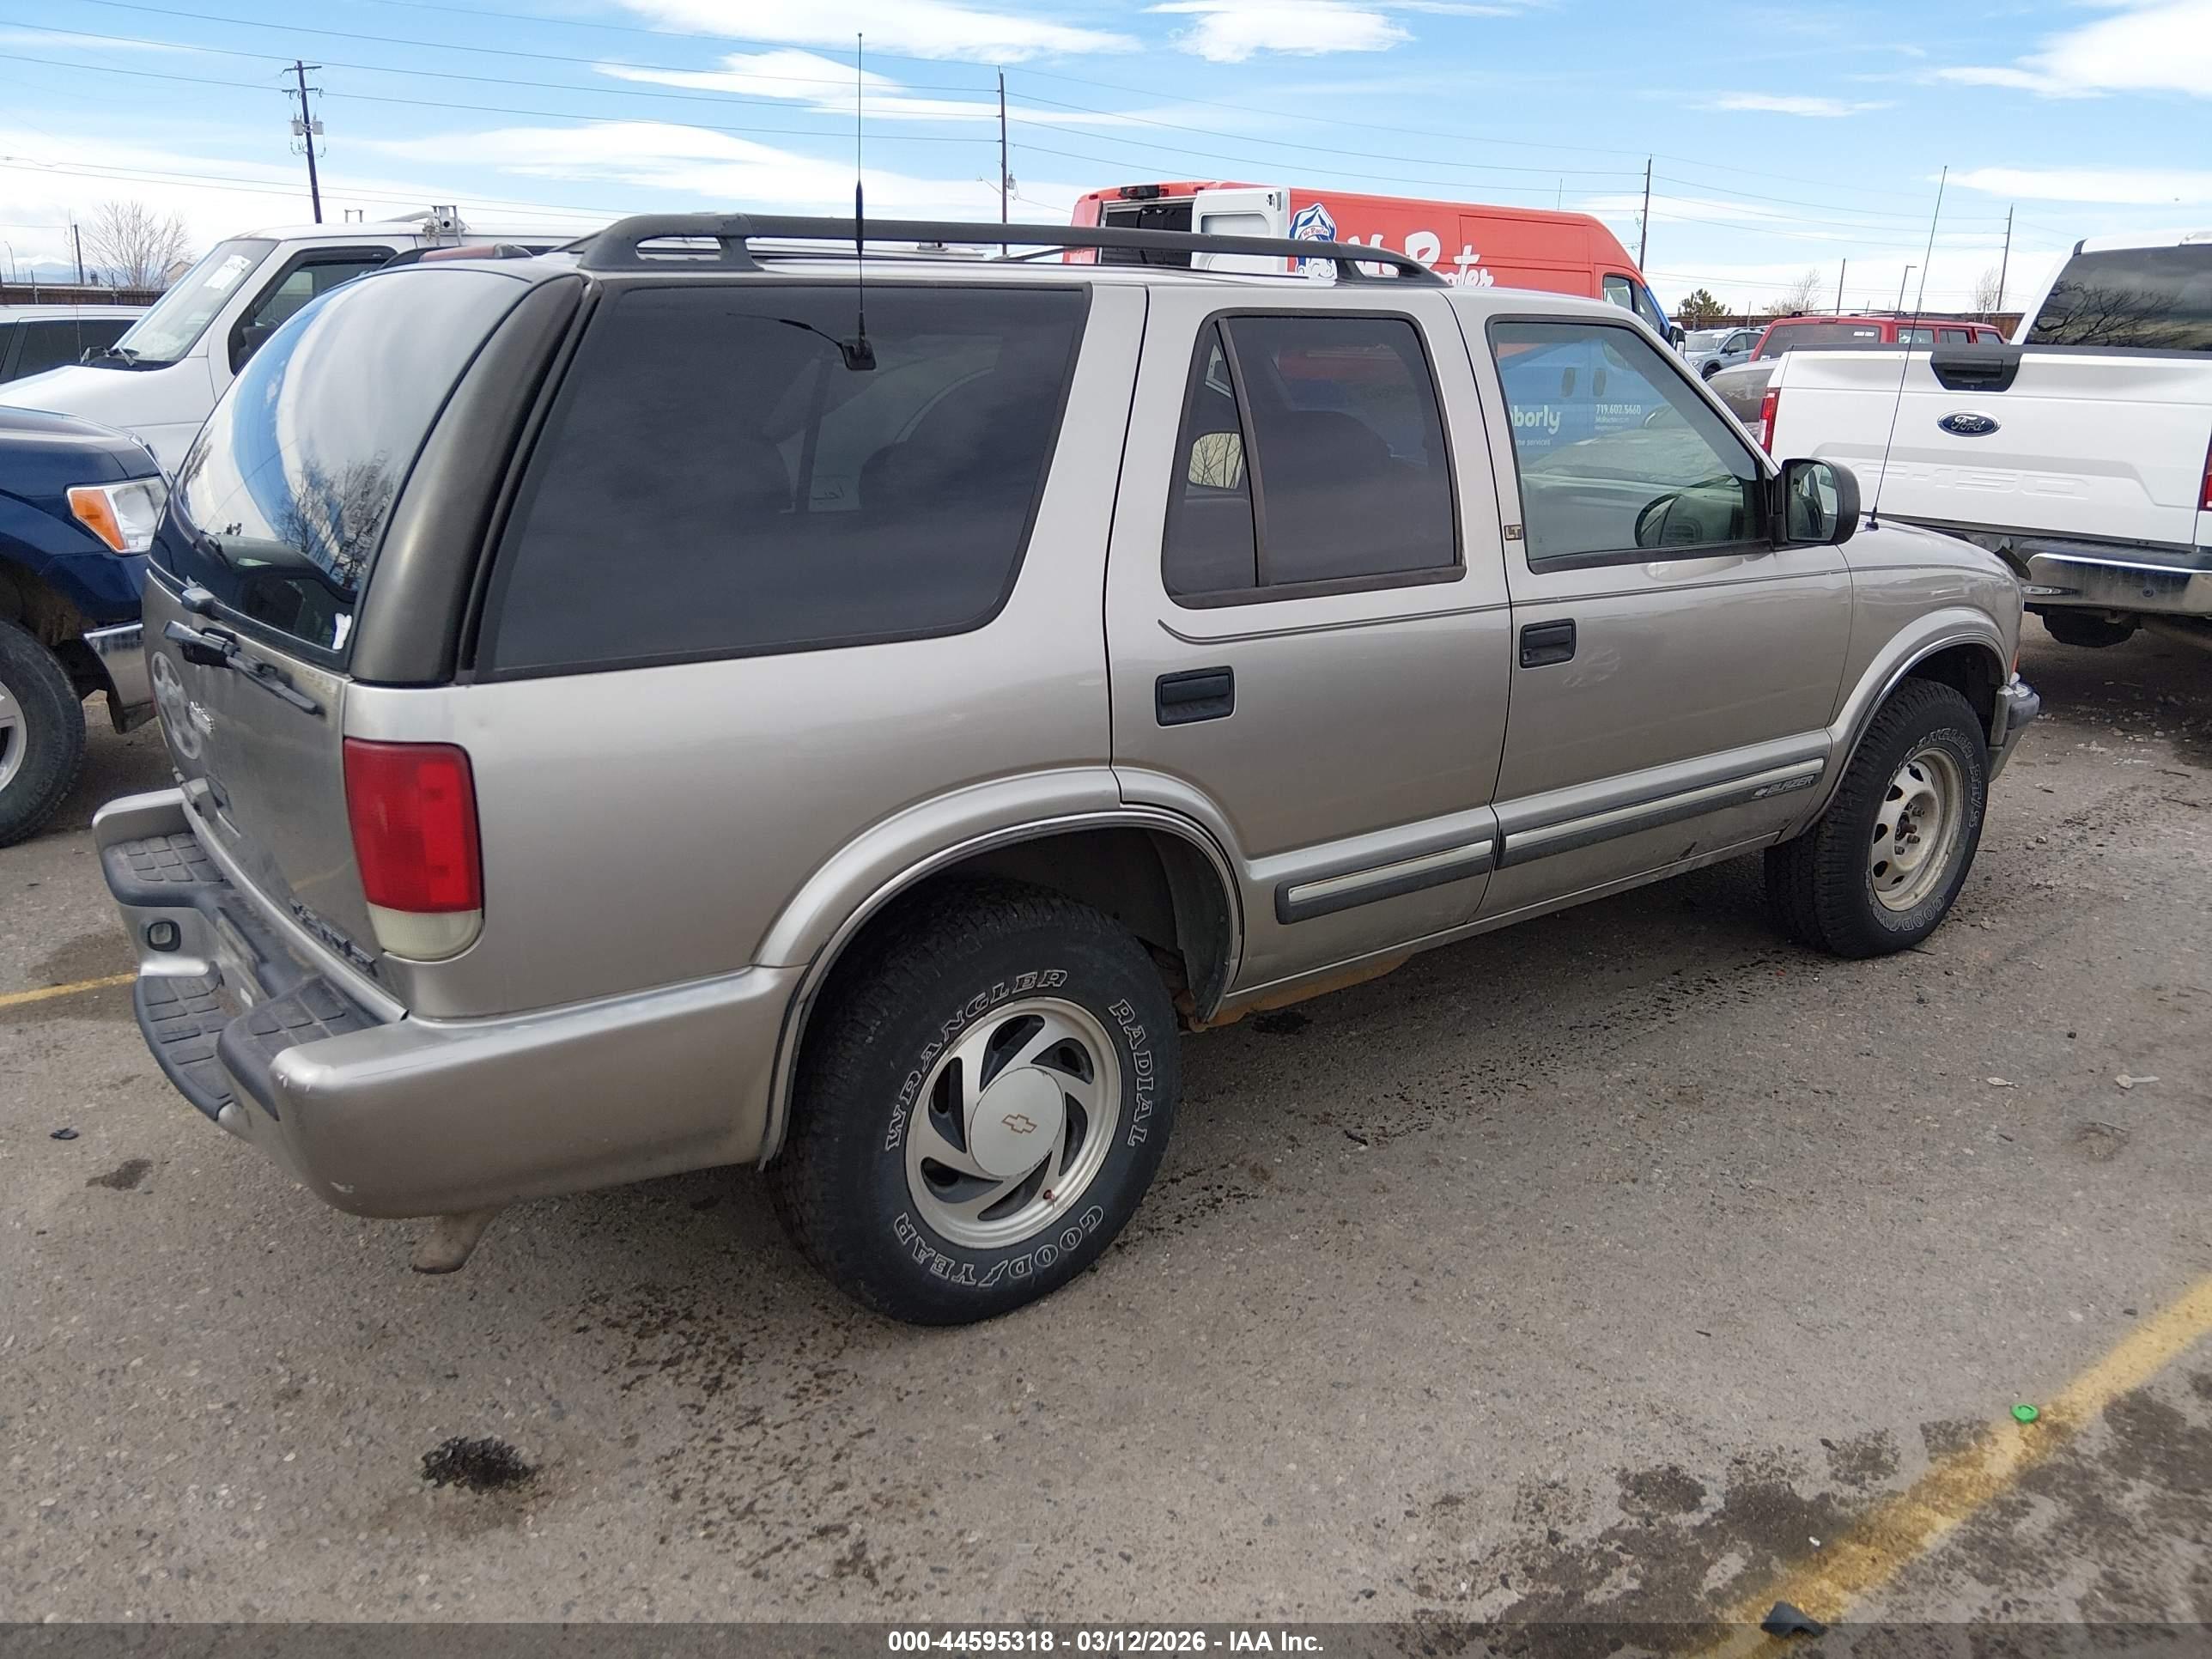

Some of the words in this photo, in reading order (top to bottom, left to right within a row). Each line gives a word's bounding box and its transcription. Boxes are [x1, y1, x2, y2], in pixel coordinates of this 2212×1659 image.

[1950, 415, 1986, 431] Ford
[1850, 462, 2090, 500] F-150
[884, 969, 1068, 1152] WRANGLER
[1108, 998, 1156, 1148] RADIAL
